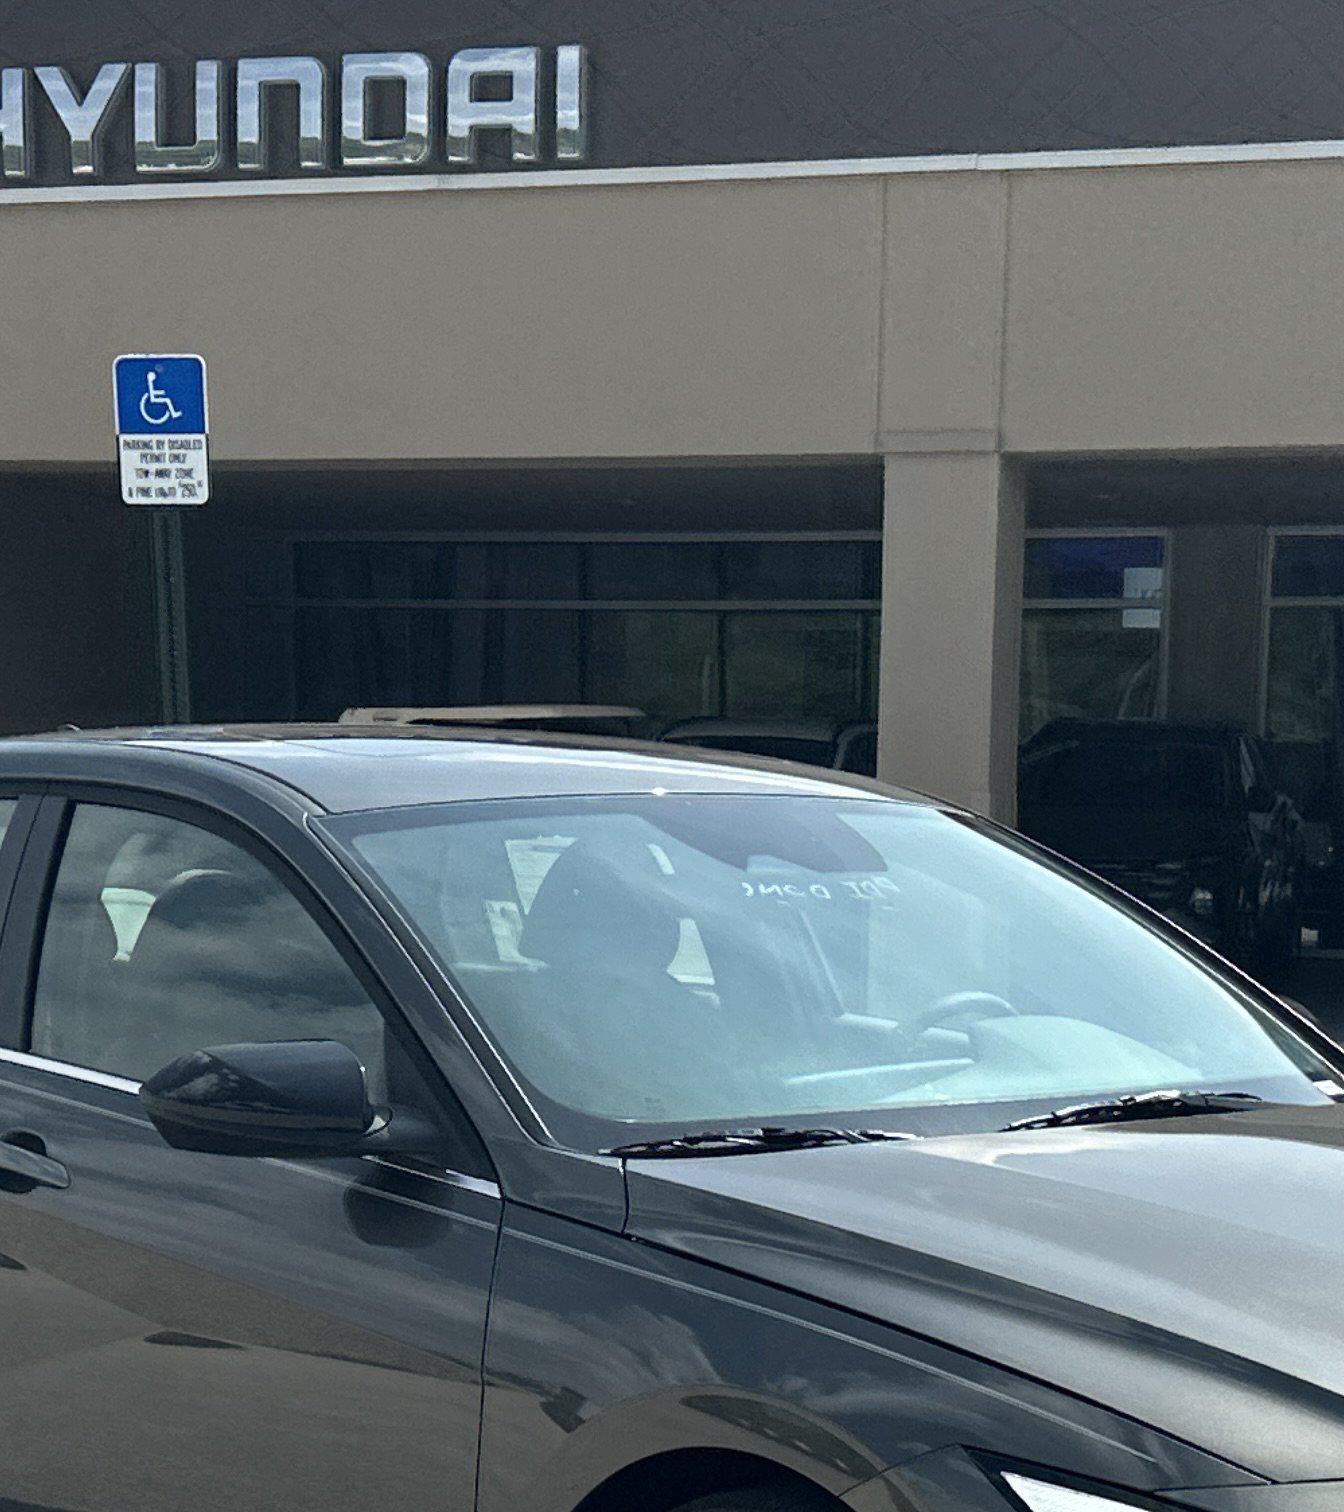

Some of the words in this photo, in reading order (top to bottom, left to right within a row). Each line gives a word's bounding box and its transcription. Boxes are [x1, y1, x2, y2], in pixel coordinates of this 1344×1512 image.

[123, 439, 154, 450] PARKING
[156, 439, 166, 450] BY
[168, 439, 203, 450] DISABLED
